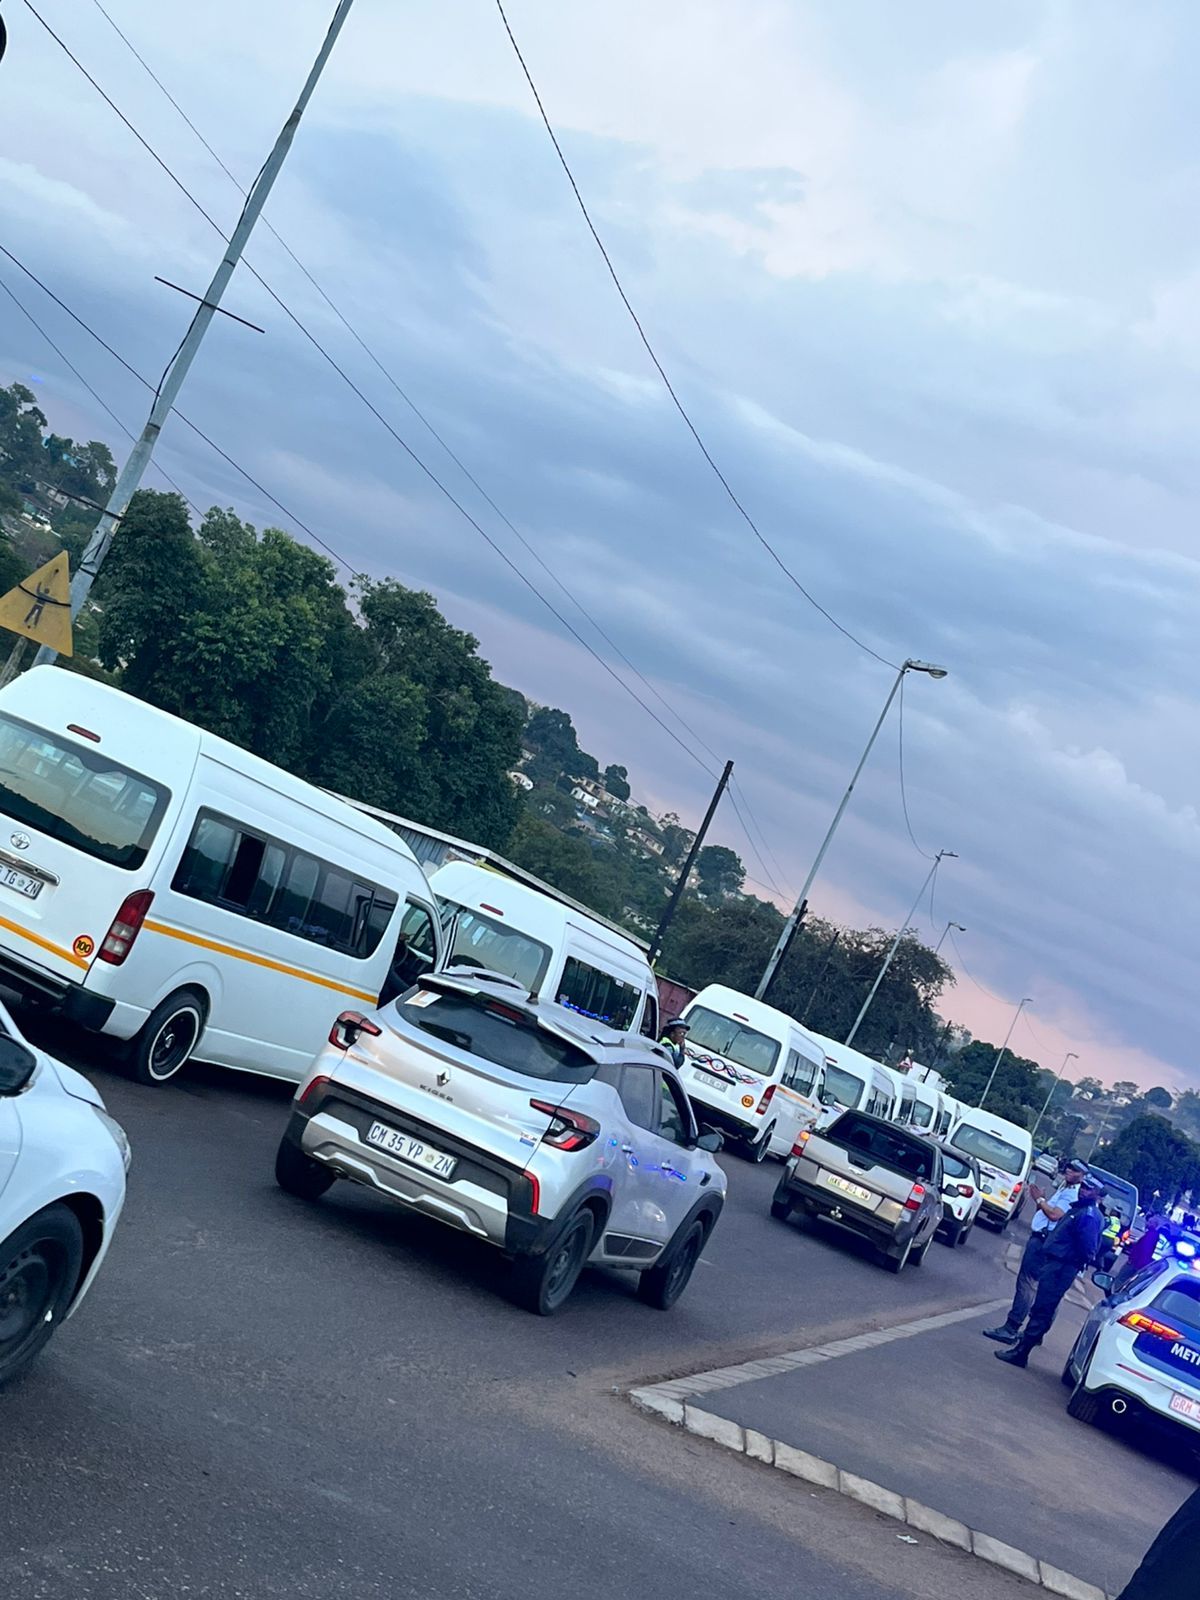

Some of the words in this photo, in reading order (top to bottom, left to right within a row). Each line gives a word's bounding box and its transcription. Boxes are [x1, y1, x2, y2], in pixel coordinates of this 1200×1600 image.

[4, 866, 18, 885] TG
[24, 879, 40, 895] ZN
[77, 940, 91, 953] 100
[420, 1084, 453, 1102] KIGER
[370, 1125, 388, 1144] CM
[388, 1133, 405, 1152] 35
[407, 1141, 423, 1159] YP
[434, 1155, 453, 1174] ZN
